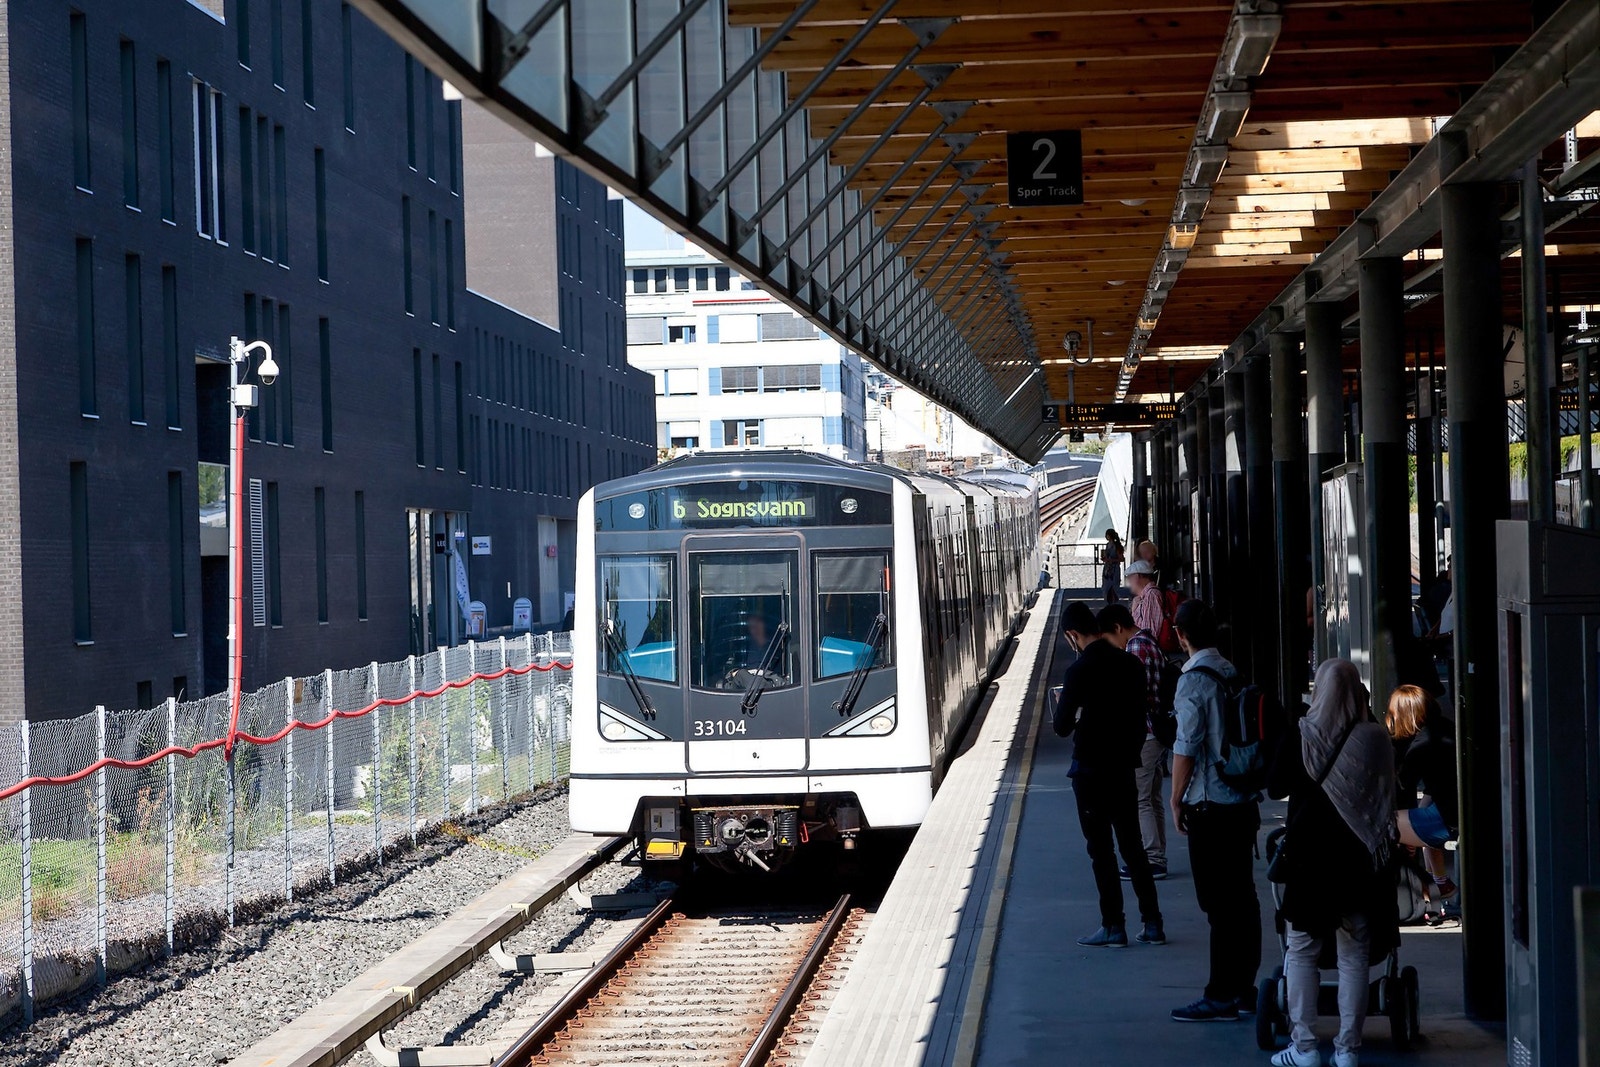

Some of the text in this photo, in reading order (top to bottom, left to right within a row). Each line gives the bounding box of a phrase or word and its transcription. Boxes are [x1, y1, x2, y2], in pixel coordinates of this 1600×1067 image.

[1032, 138, 1057, 179] 2
[1017, 186, 1076, 198] Spor Track
[1513, 380, 1520, 389] 5
[1047, 407, 1054, 418] 2
[697, 497, 806, 518] Sognsvann
[694, 719, 746, 736] 33104
